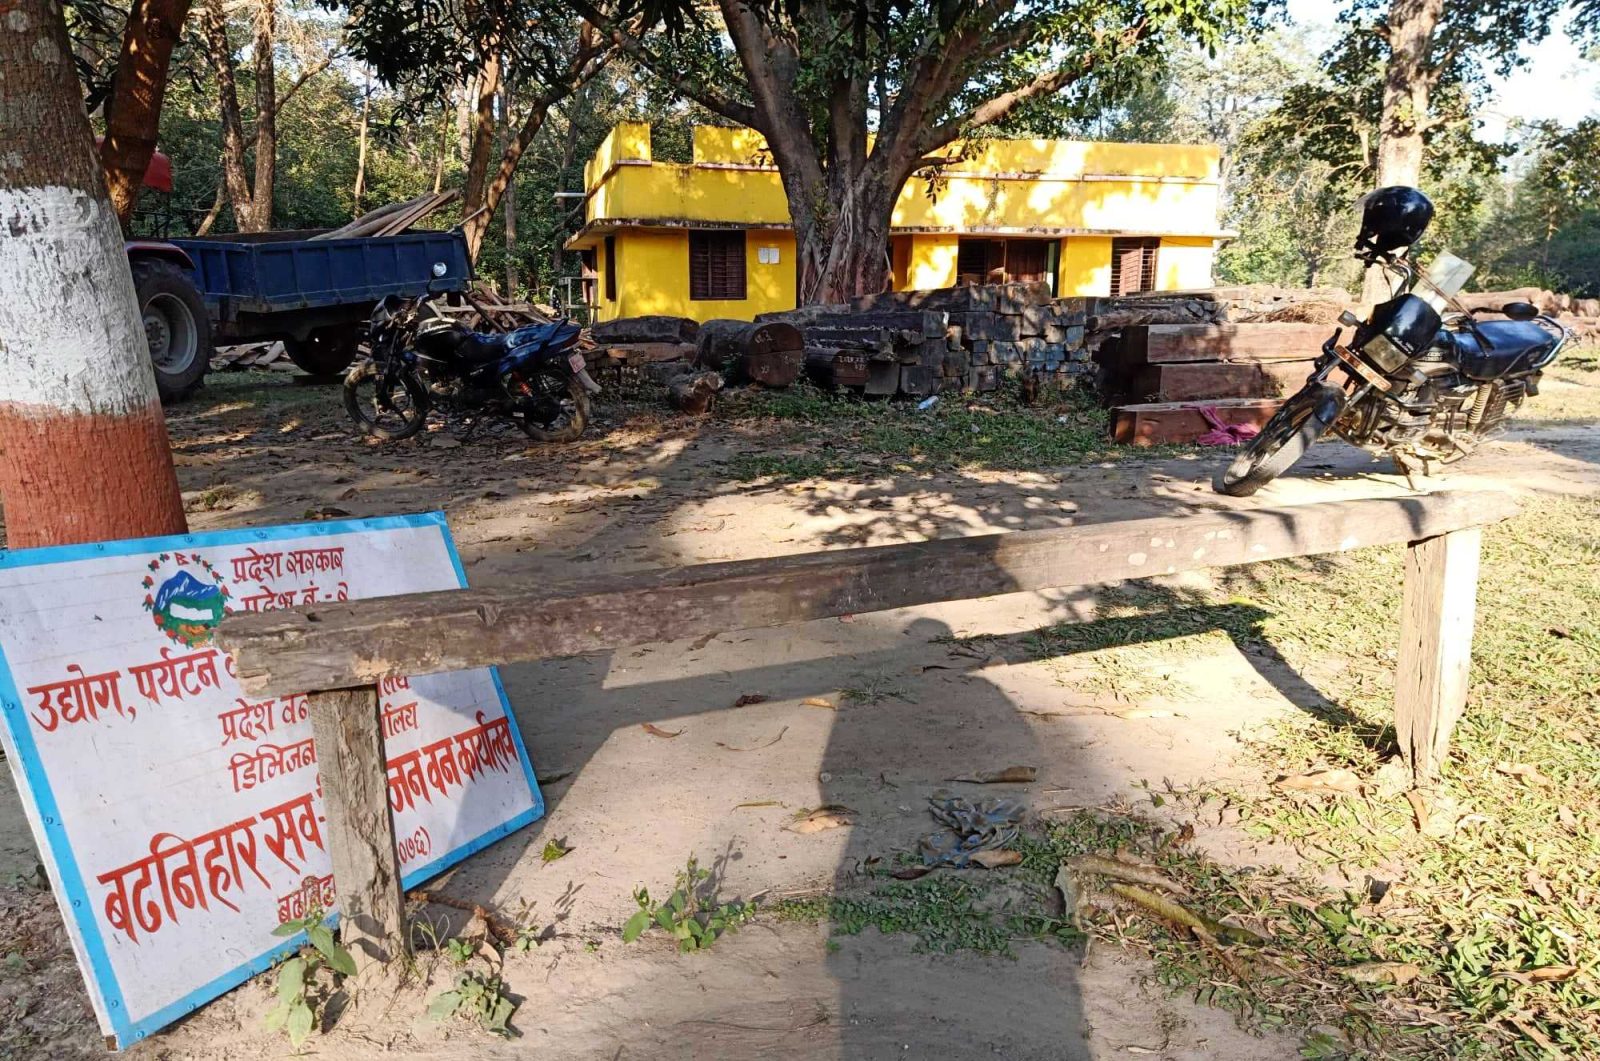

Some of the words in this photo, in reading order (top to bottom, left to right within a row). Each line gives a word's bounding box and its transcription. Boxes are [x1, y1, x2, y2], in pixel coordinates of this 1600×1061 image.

[231, 547, 283, 584] प्रदेश
[286, 547, 344, 580] सरकार
[27, 664, 136, 732] उद्योग,
[128, 647, 221, 706] पर्यटन
[218, 698, 275, 746] प्रदेश
[228, 738, 317, 793] डिभिजन
[97, 817, 271, 945] बढनिहार
[260, 776, 326, 875] सव-
[421, 736, 463, 798] वन
[454, 710, 518, 785] कार्यालय
